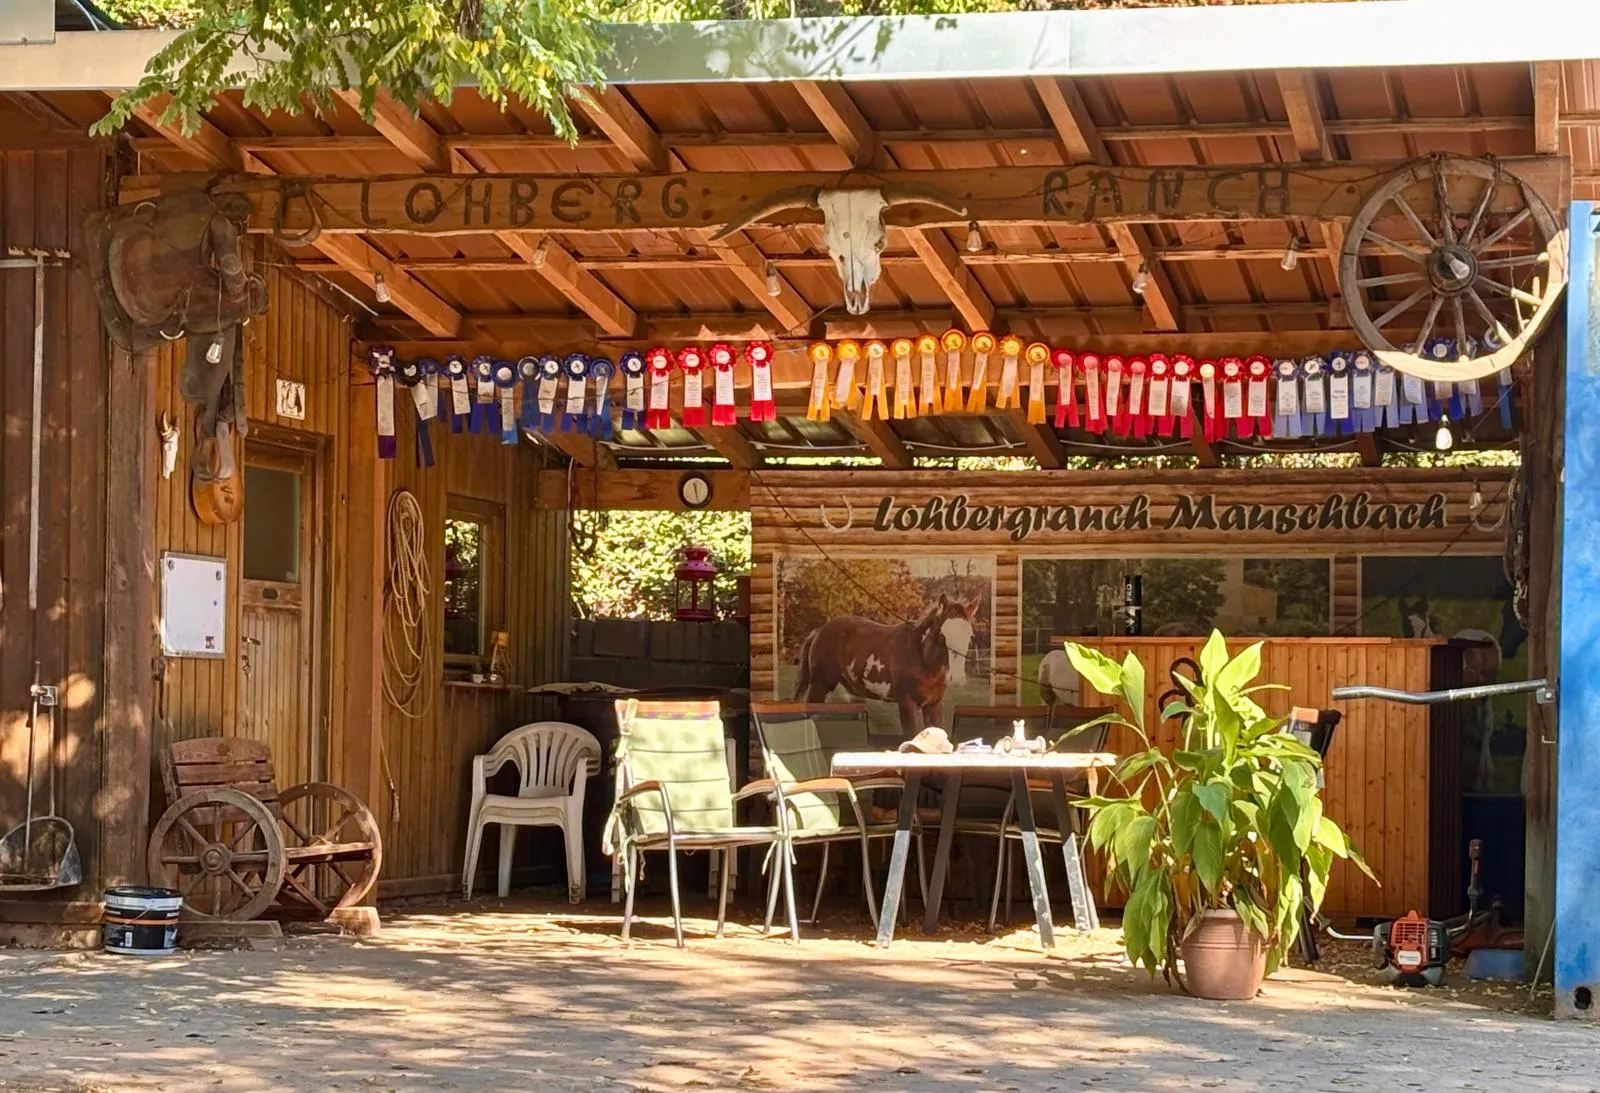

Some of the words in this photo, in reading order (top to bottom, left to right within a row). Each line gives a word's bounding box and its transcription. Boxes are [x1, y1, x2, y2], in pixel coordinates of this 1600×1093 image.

[360, 176, 690, 228] LOHBERG
[1043, 168, 1290, 222] RANCH
[873, 494, 1152, 542] Lohbergranch
[1163, 492, 1448, 535] Mauschbach
